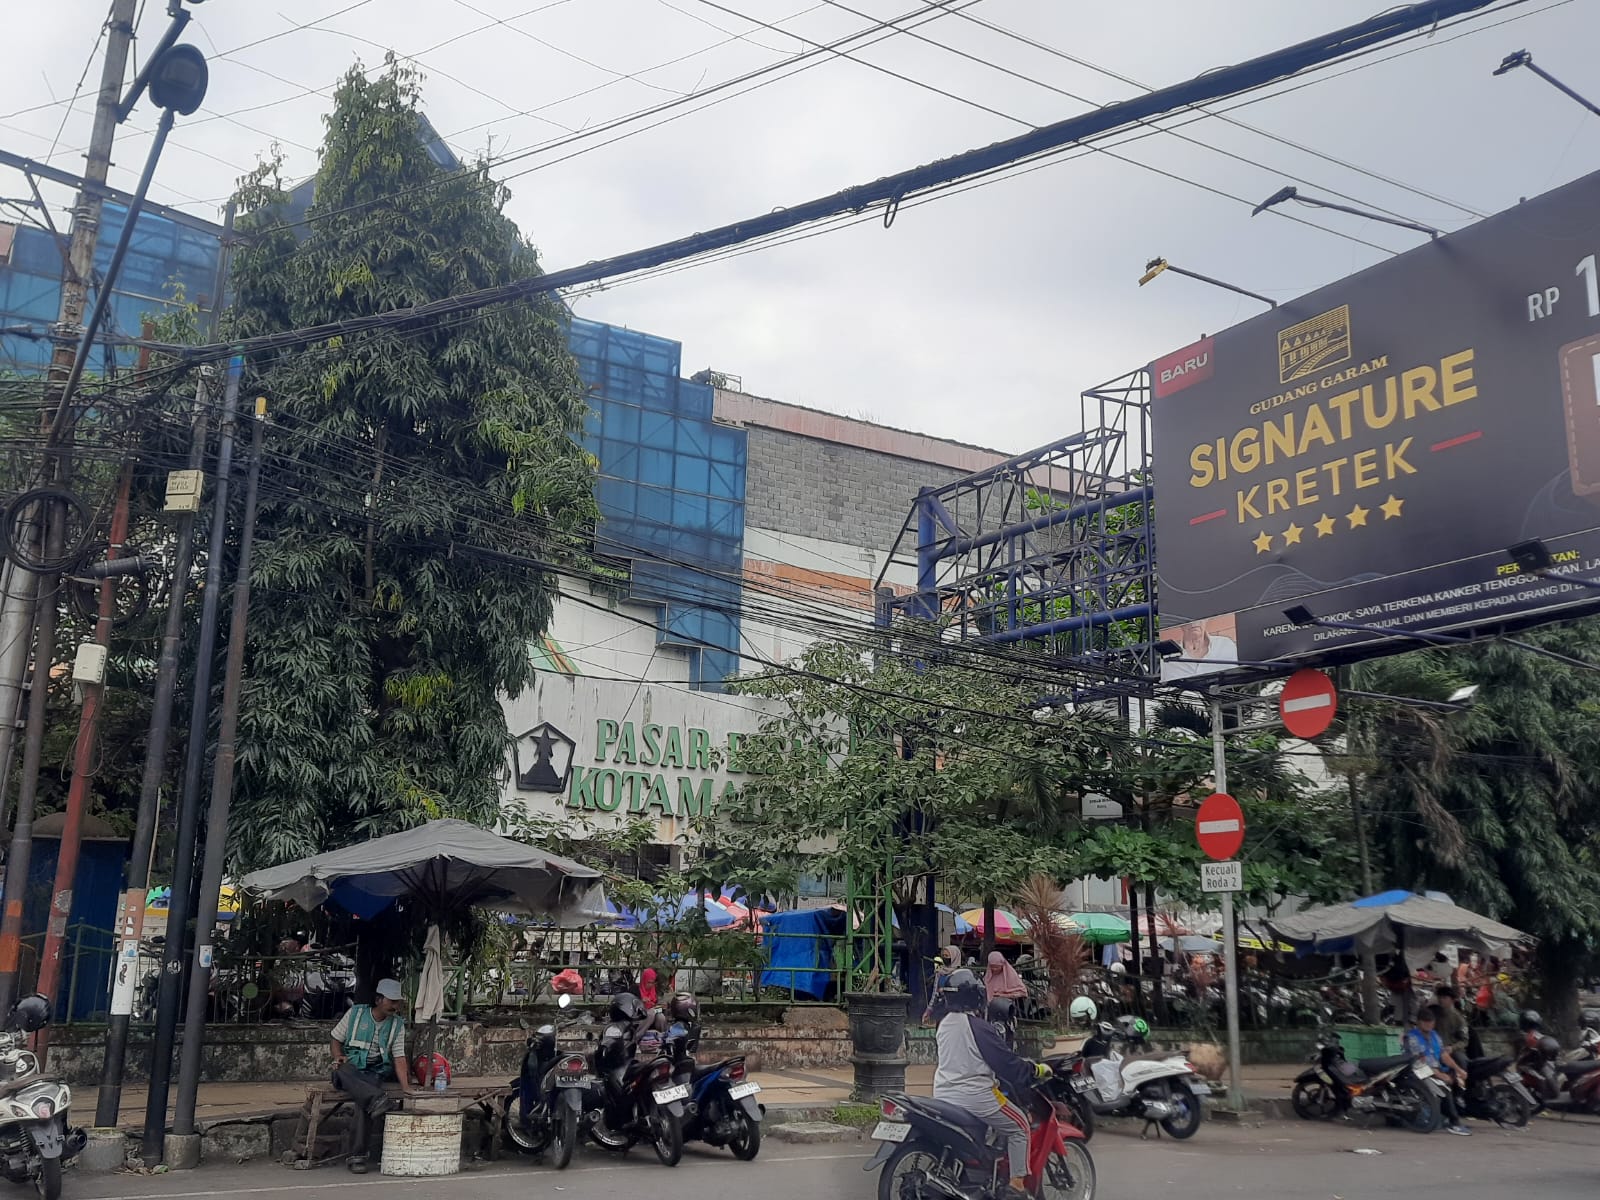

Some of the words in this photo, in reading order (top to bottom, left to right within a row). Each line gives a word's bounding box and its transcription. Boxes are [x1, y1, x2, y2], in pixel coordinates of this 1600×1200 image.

[1527, 287, 1560, 322] RP
[1160, 351, 1208, 384] BARU
[1249, 381, 1318, 415] GUDANG
[1320, 355, 1389, 389] GARAM
[1189, 348, 1478, 487] SIGNATURE
[1237, 436, 1418, 524] KRETEK
[1356, 605, 1382, 618] SAYA
[1383, 593, 1432, 612] TERKENA
[1435, 583, 1481, 602] KANKER
[1404, 612, 1425, 624] DAN
[1426, 604, 1472, 619] MEMBERI
[1474, 595, 1516, 610] KEPADA
[1517, 585, 1558, 601] ORANG
[1560, 583, 1573, 593] DI
[595, 718, 709, 770] PASAR
[1205, 863, 1237, 876] Kecuali
[1207, 877, 1228, 888] Roda
[1232, 876, 1237, 888] 2
